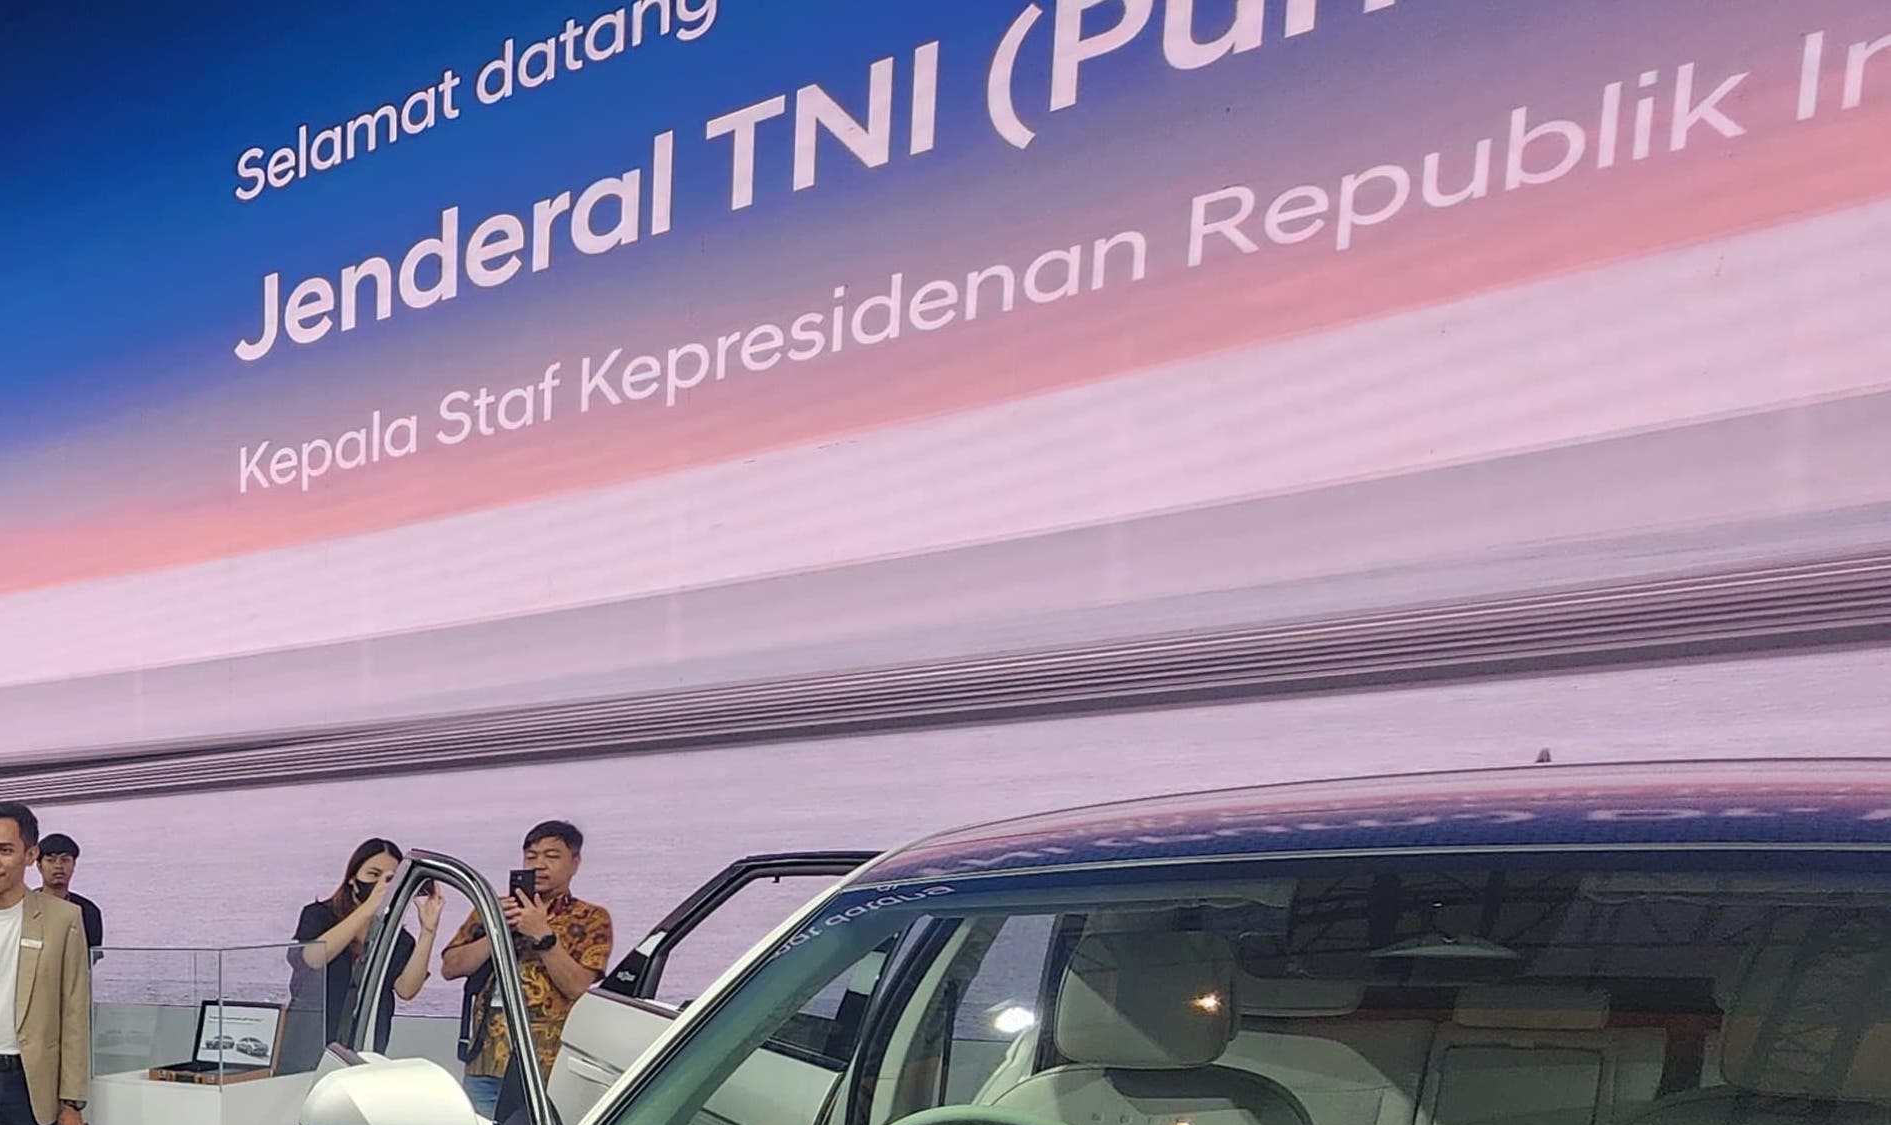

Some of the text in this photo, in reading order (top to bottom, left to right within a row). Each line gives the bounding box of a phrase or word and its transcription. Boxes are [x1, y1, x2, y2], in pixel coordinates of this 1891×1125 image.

[233, 130, 677, 363] Jenderal
[705, 41, 940, 211] TNI
[234, 0, 717, 202] Selamat datang
[239, 411, 418, 494] Kepala
[437, 362, 562, 448] Staf
[579, 231, 1148, 414] Kepresidenan
[1186, 60, 1752, 269] Republik
